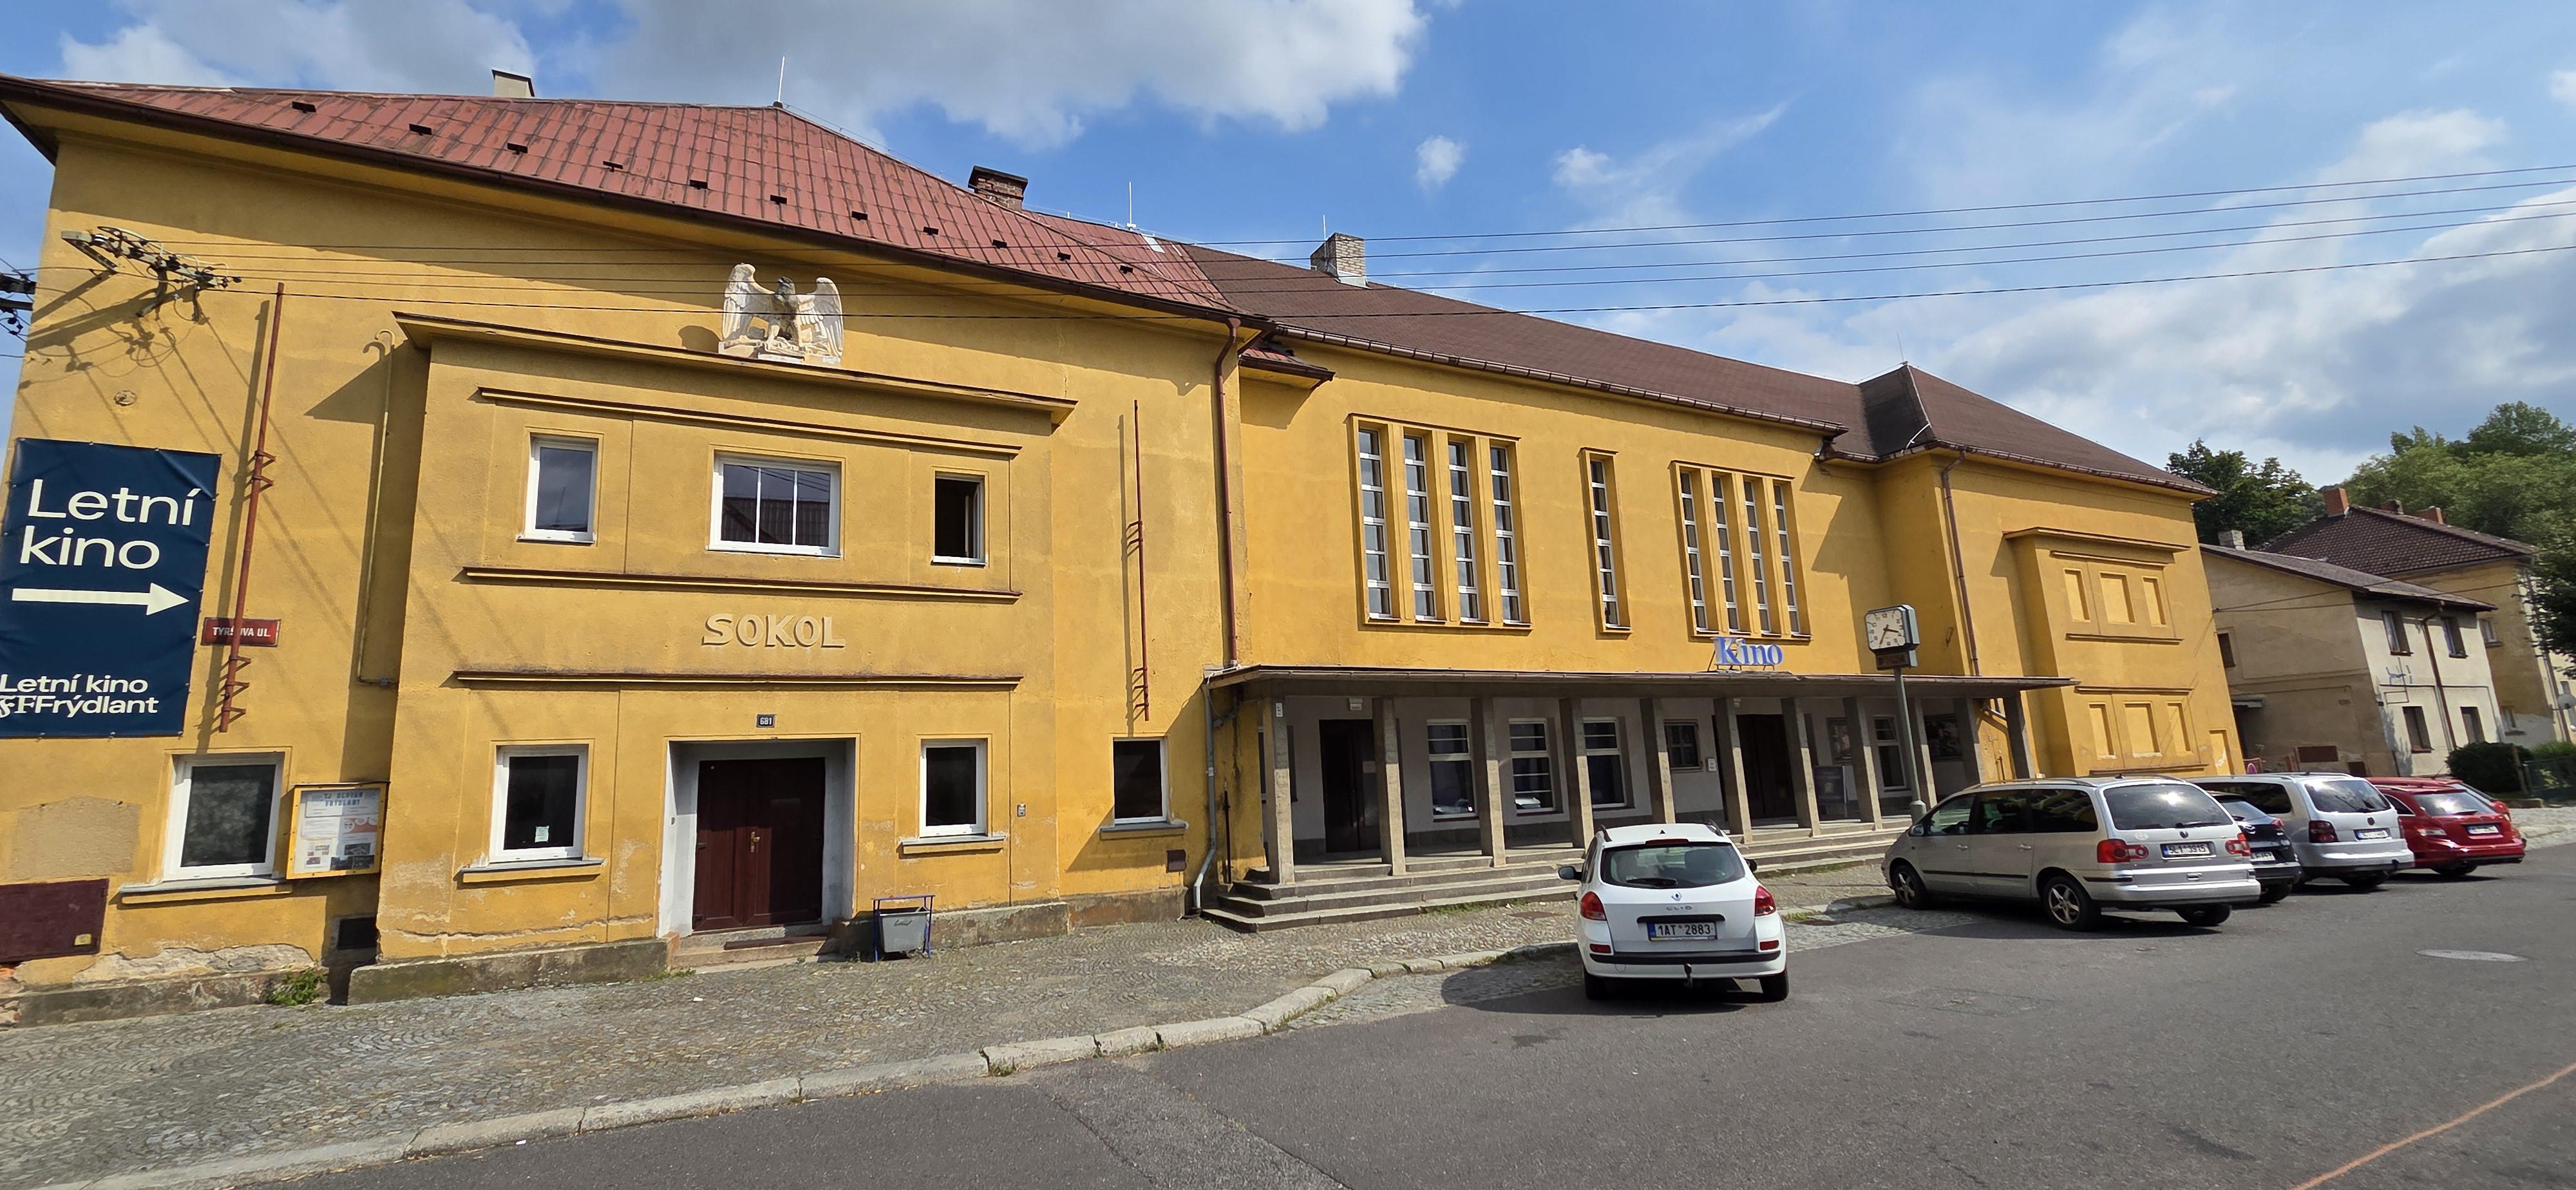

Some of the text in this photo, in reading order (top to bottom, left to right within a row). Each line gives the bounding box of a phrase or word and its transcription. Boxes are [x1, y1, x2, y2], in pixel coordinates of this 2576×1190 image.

[28, 478, 202, 526] Letní
[20, 525, 160, 569] kino
[701, 613, 846, 648] SOKOL
[1712, 636, 1783, 665] Kino
[0, 674, 148, 693] Letní kino
[760, 717, 772, 725] 681
[1658, 924, 1711, 936] 1AT 2883
